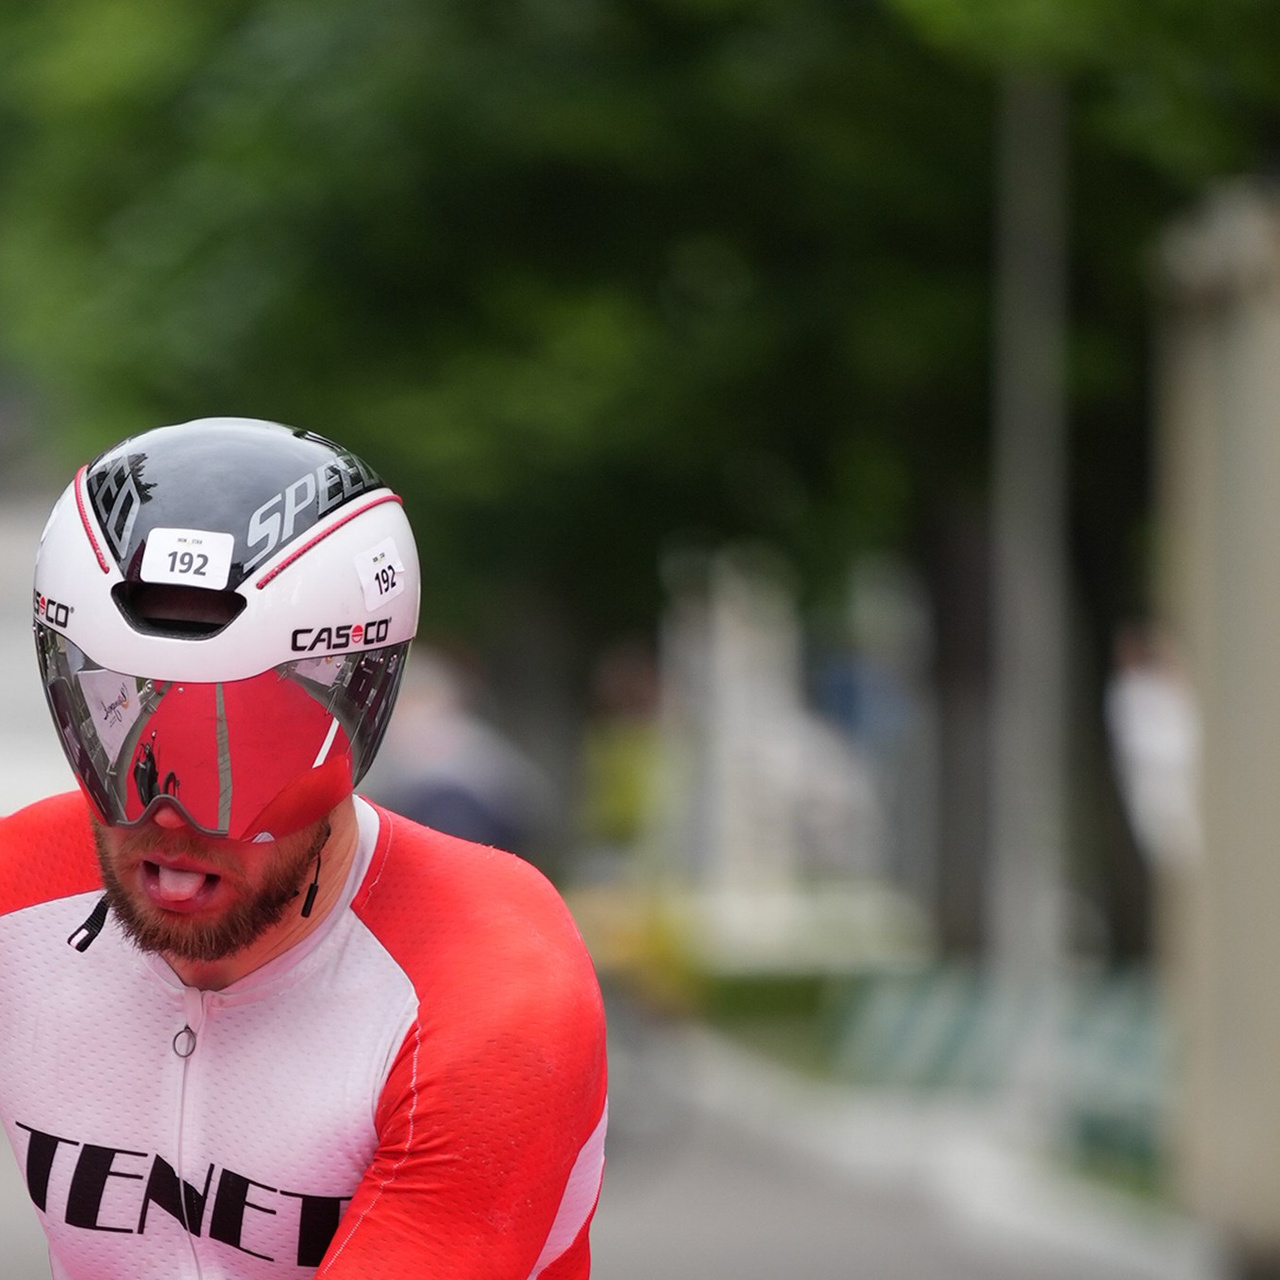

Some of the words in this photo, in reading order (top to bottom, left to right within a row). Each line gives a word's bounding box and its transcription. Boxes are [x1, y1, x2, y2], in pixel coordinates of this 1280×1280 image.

[168, 551, 209, 577] 192
[374, 564, 397, 595] 192
[15, 1120, 353, 1268] TENET
